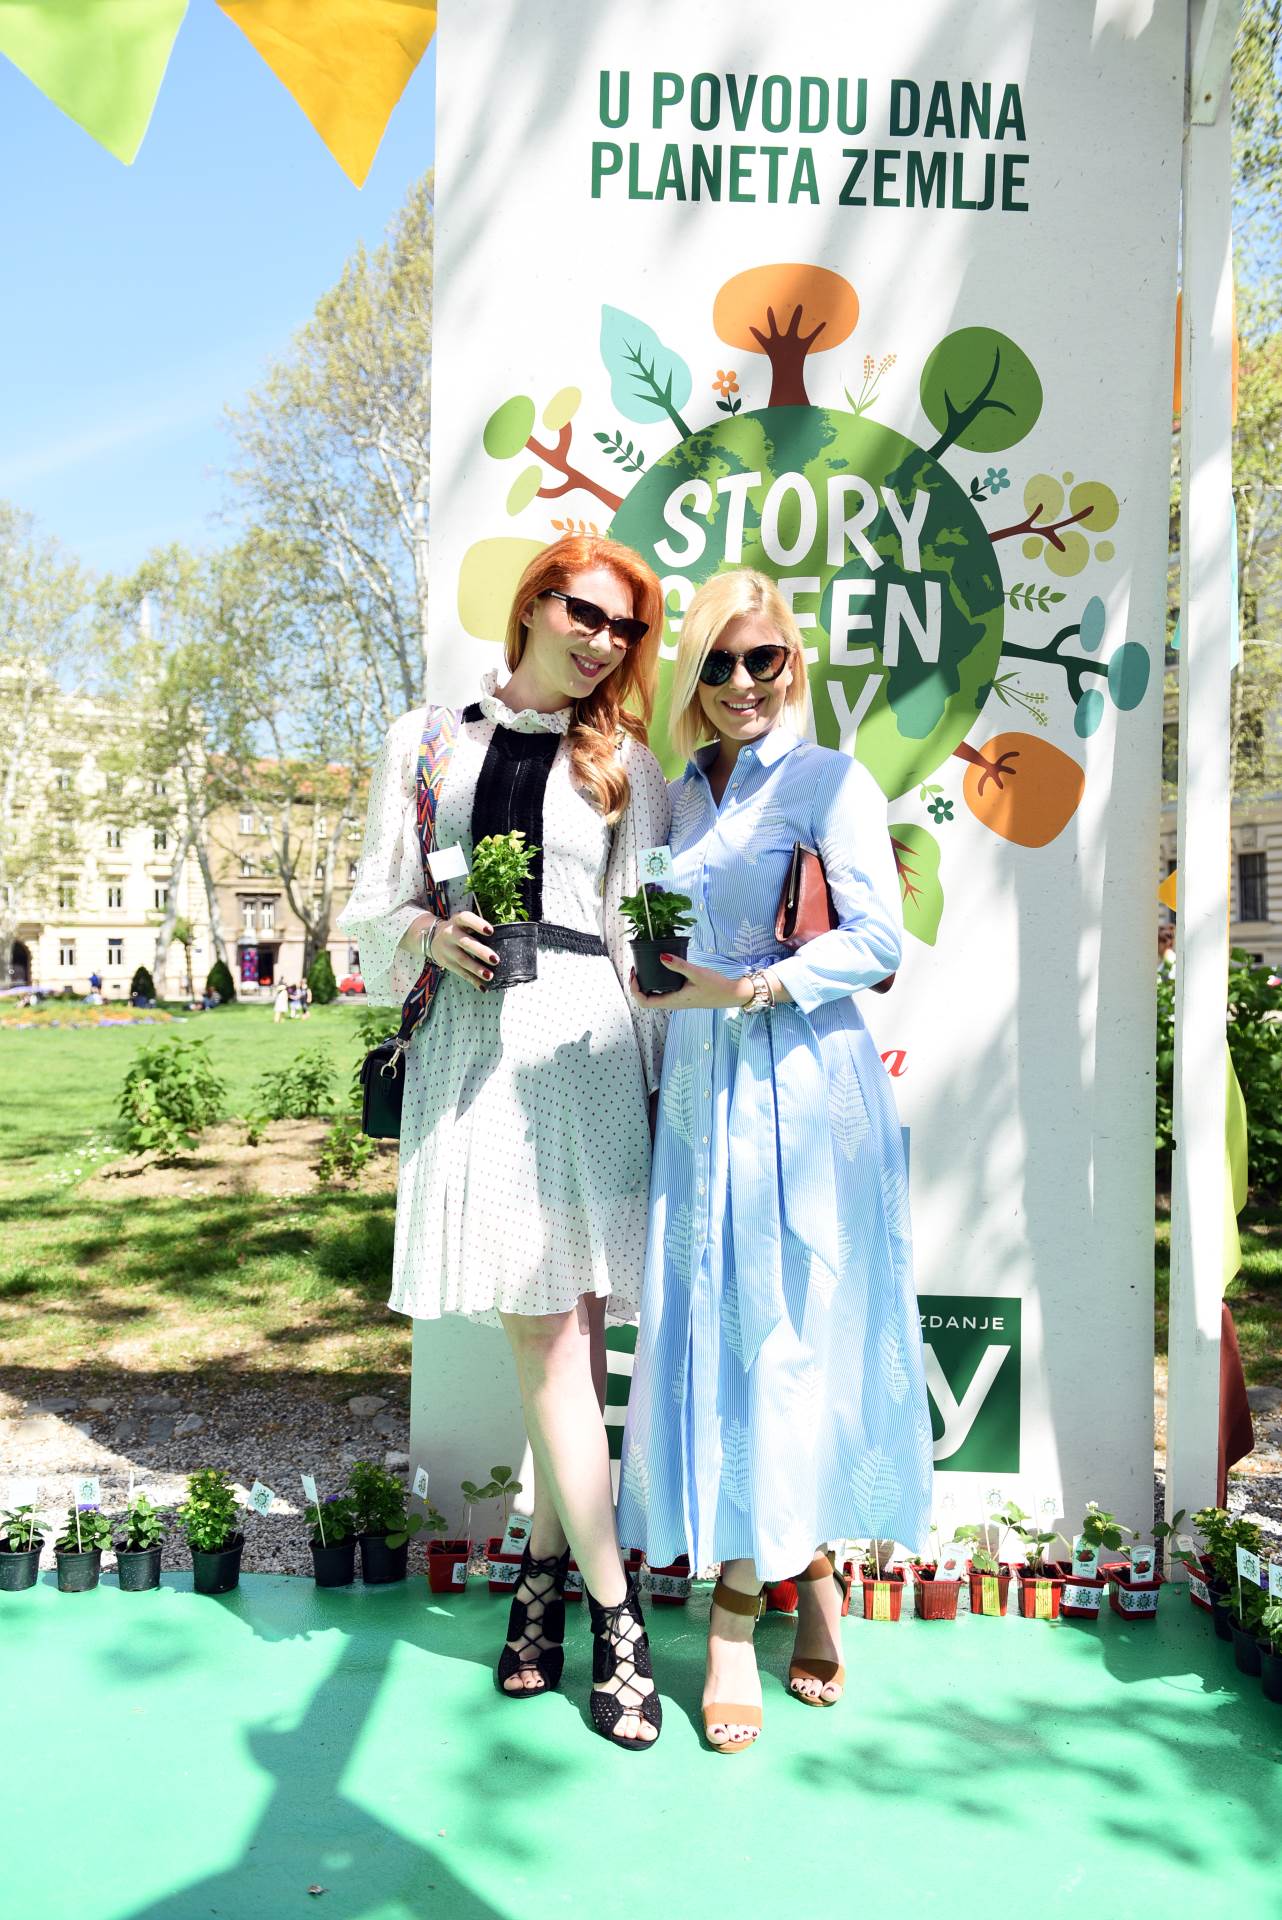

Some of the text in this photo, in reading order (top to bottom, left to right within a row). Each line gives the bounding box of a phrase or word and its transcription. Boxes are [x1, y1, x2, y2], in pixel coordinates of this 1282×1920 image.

[599, 70, 1026, 141] U POVODU DANA
[591, 141, 1030, 212] PLANETA ZEMLJE
[653, 471, 931, 573] STORY
[919, 1315, 1005, 1331] ZDANJE
